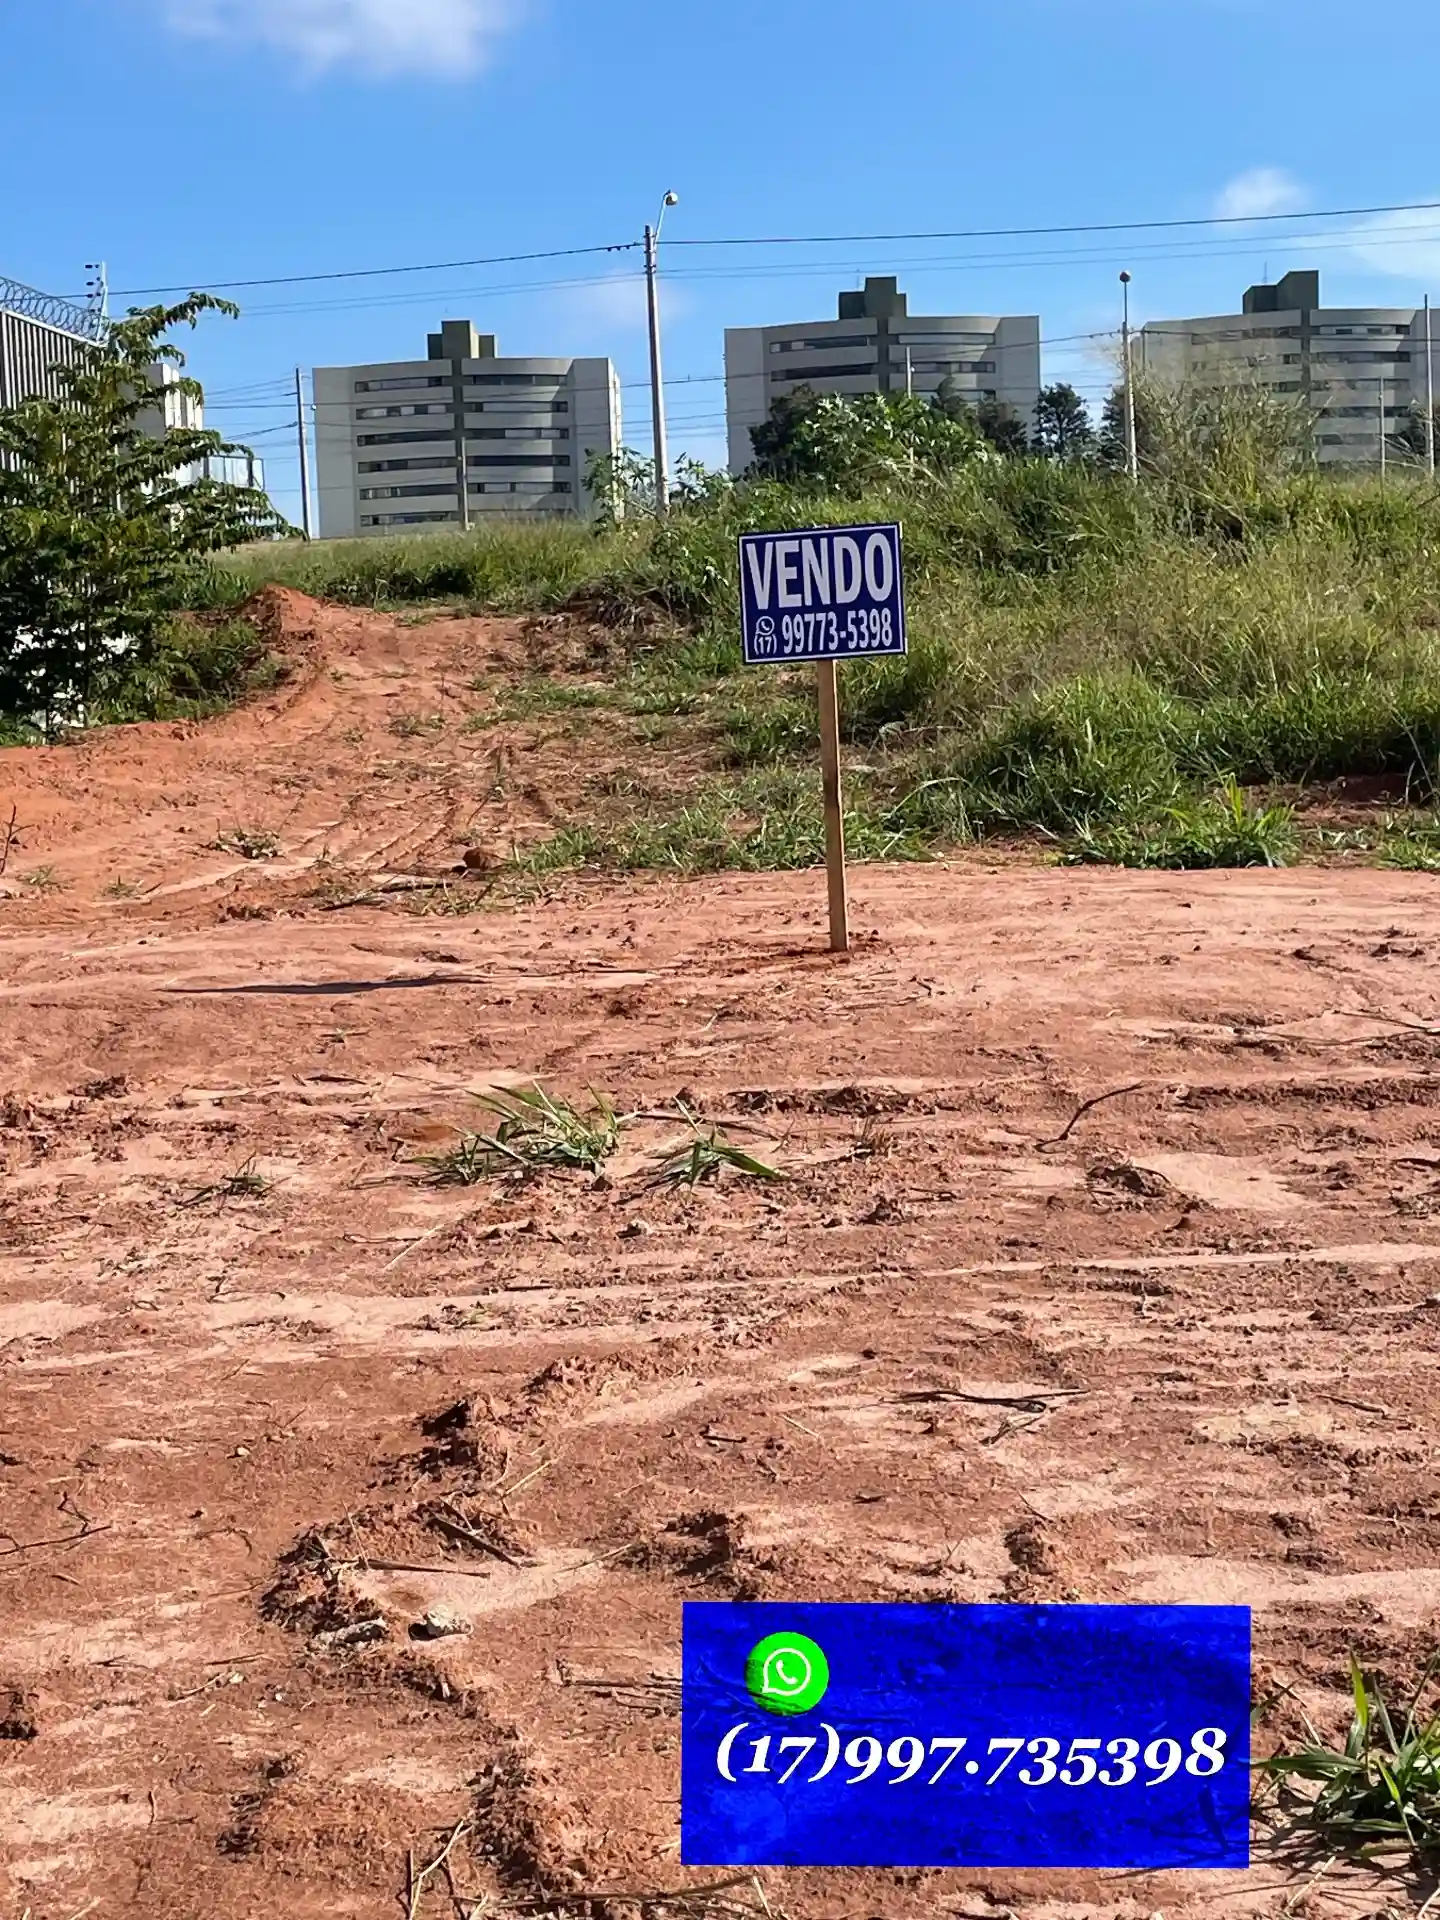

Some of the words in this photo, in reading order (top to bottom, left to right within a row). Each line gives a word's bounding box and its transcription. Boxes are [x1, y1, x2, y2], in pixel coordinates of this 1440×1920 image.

[745, 532, 894, 611] VENDO
[753, 633, 778, 655] (17)
[781, 607, 893, 654] 99773-5398
